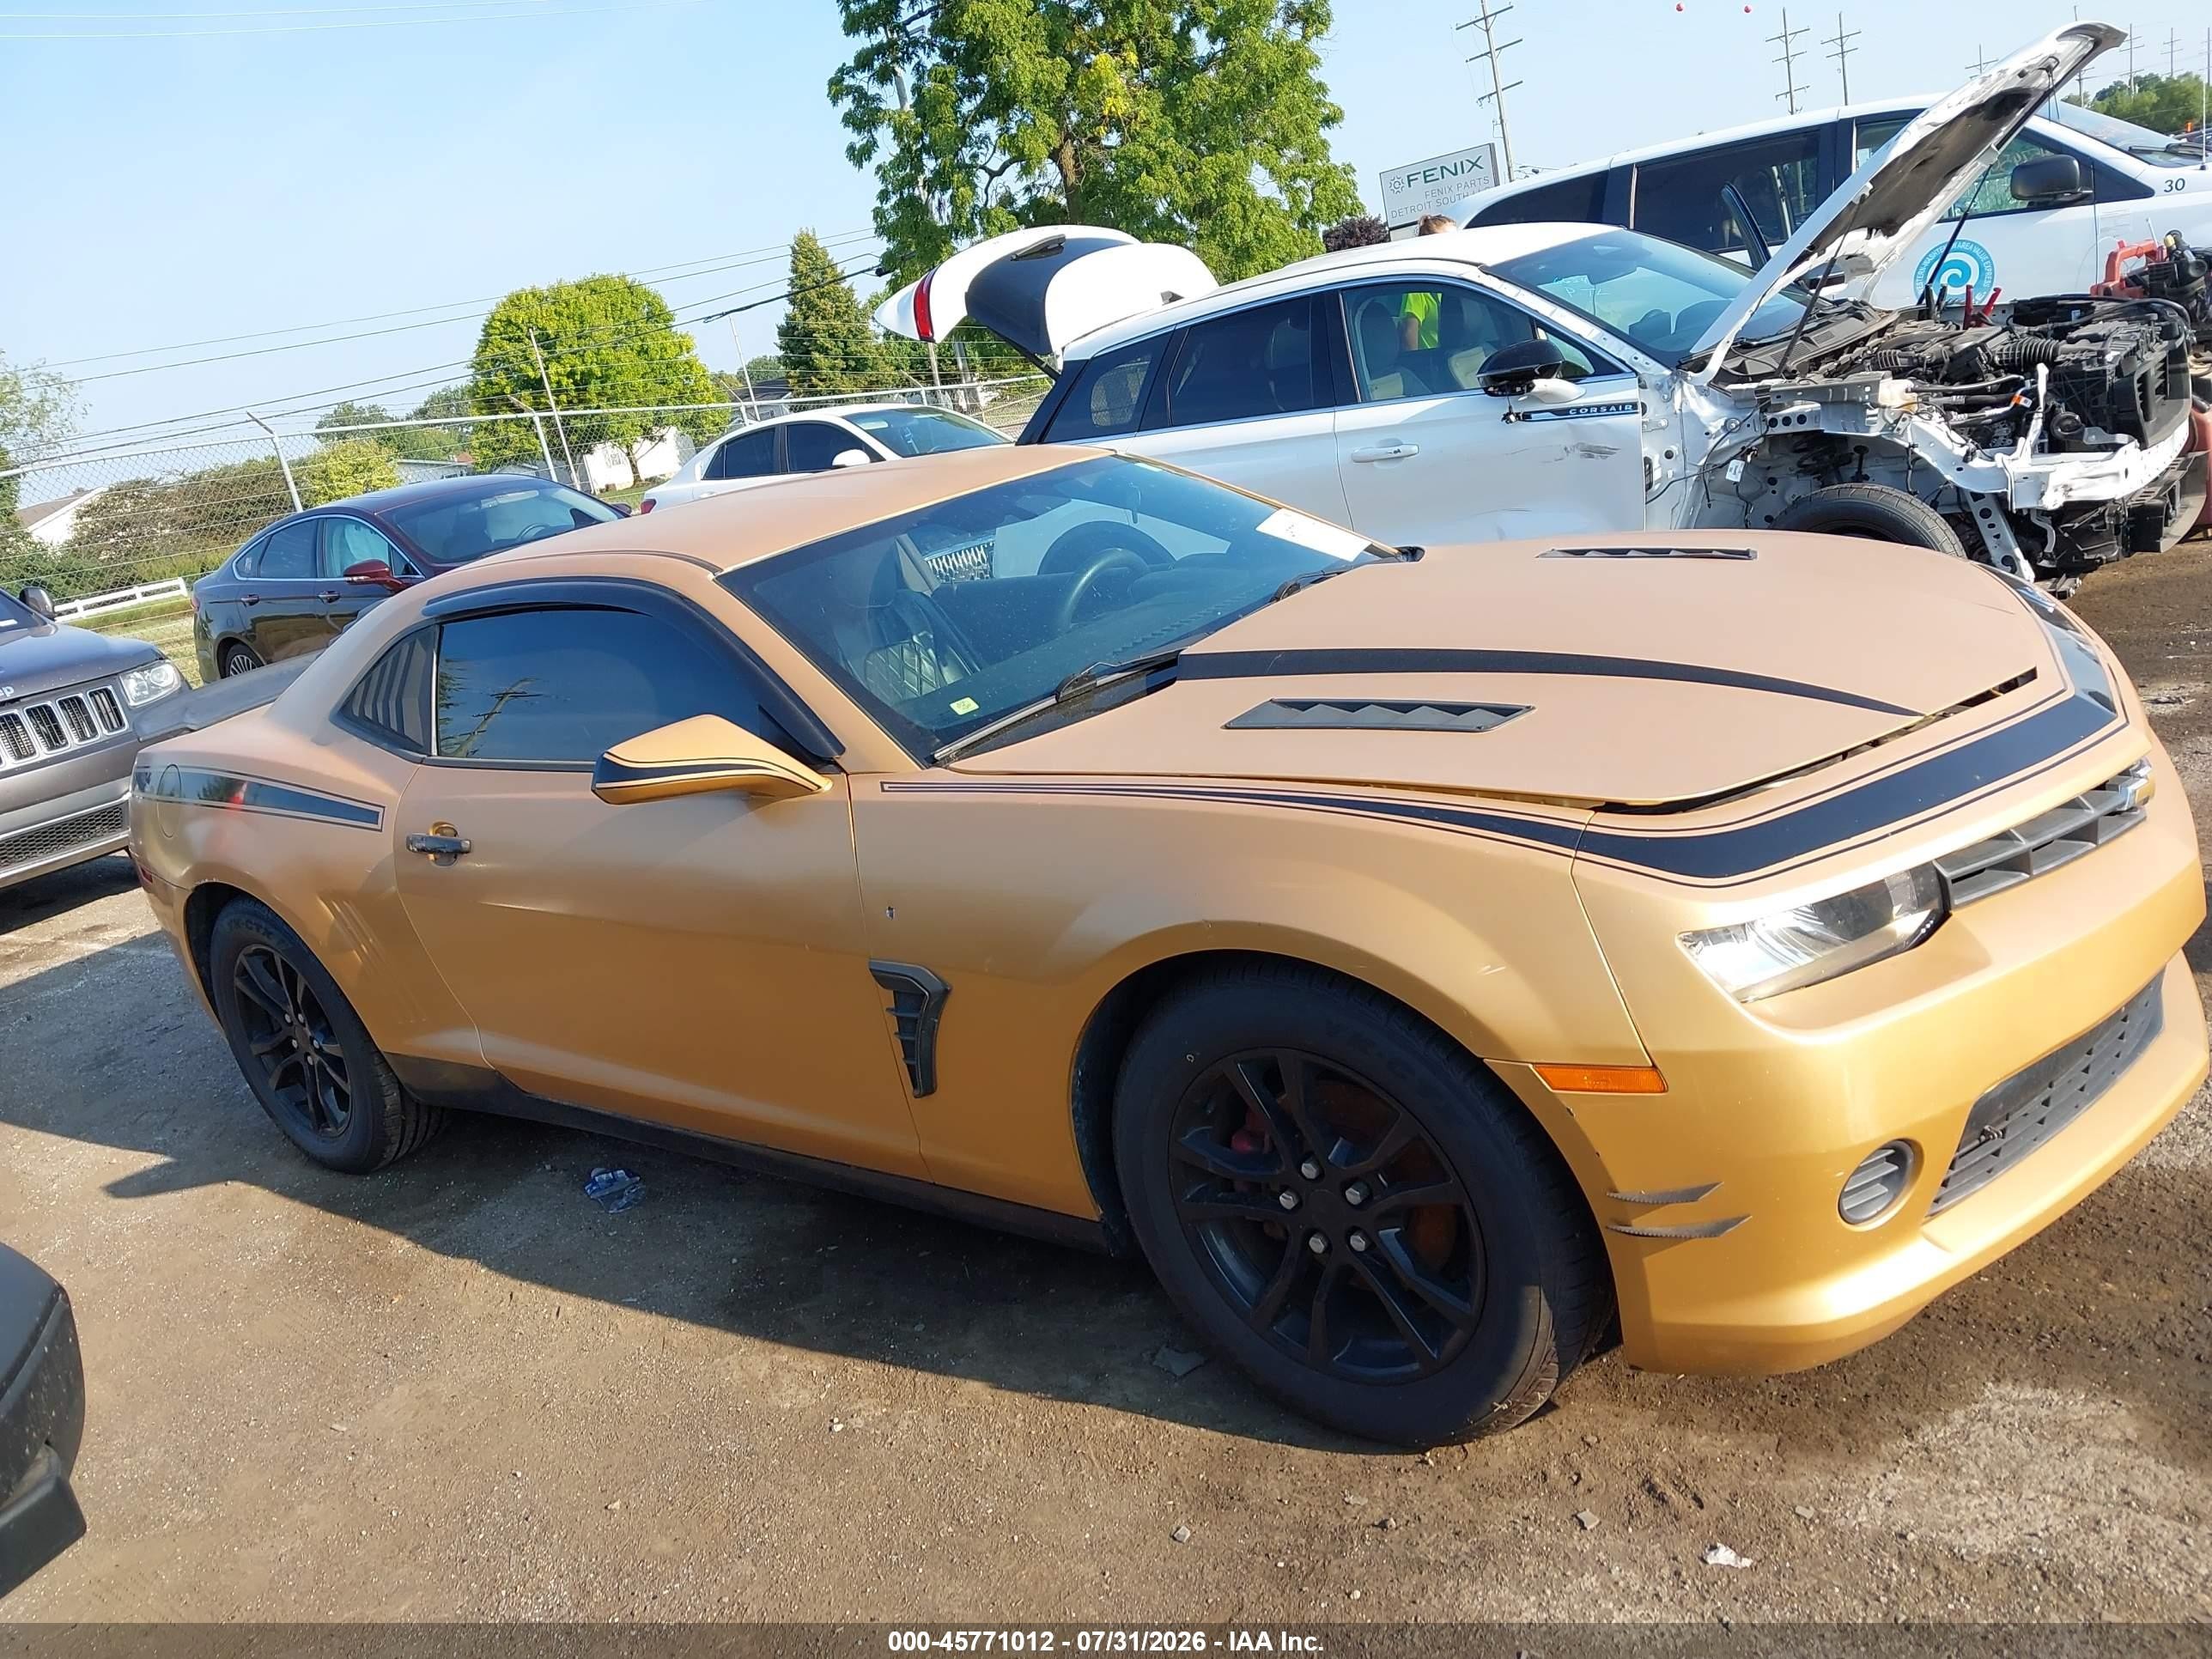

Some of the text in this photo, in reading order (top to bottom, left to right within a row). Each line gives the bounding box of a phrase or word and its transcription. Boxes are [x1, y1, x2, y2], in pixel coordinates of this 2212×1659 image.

[1407, 155, 1485, 188] FENIX
[1425, 185, 1455, 200] FENIX
[1456, 176, 1491, 191] PARTS
[2163, 178, 2186, 193] 30
[1390, 191, 1470, 219] DETROIT SOUTH
[1957, 241, 1974, 252] AREA
[1972, 245, 1988, 263] VALUE
[1569, 404, 1633, 416] CORSAIR
